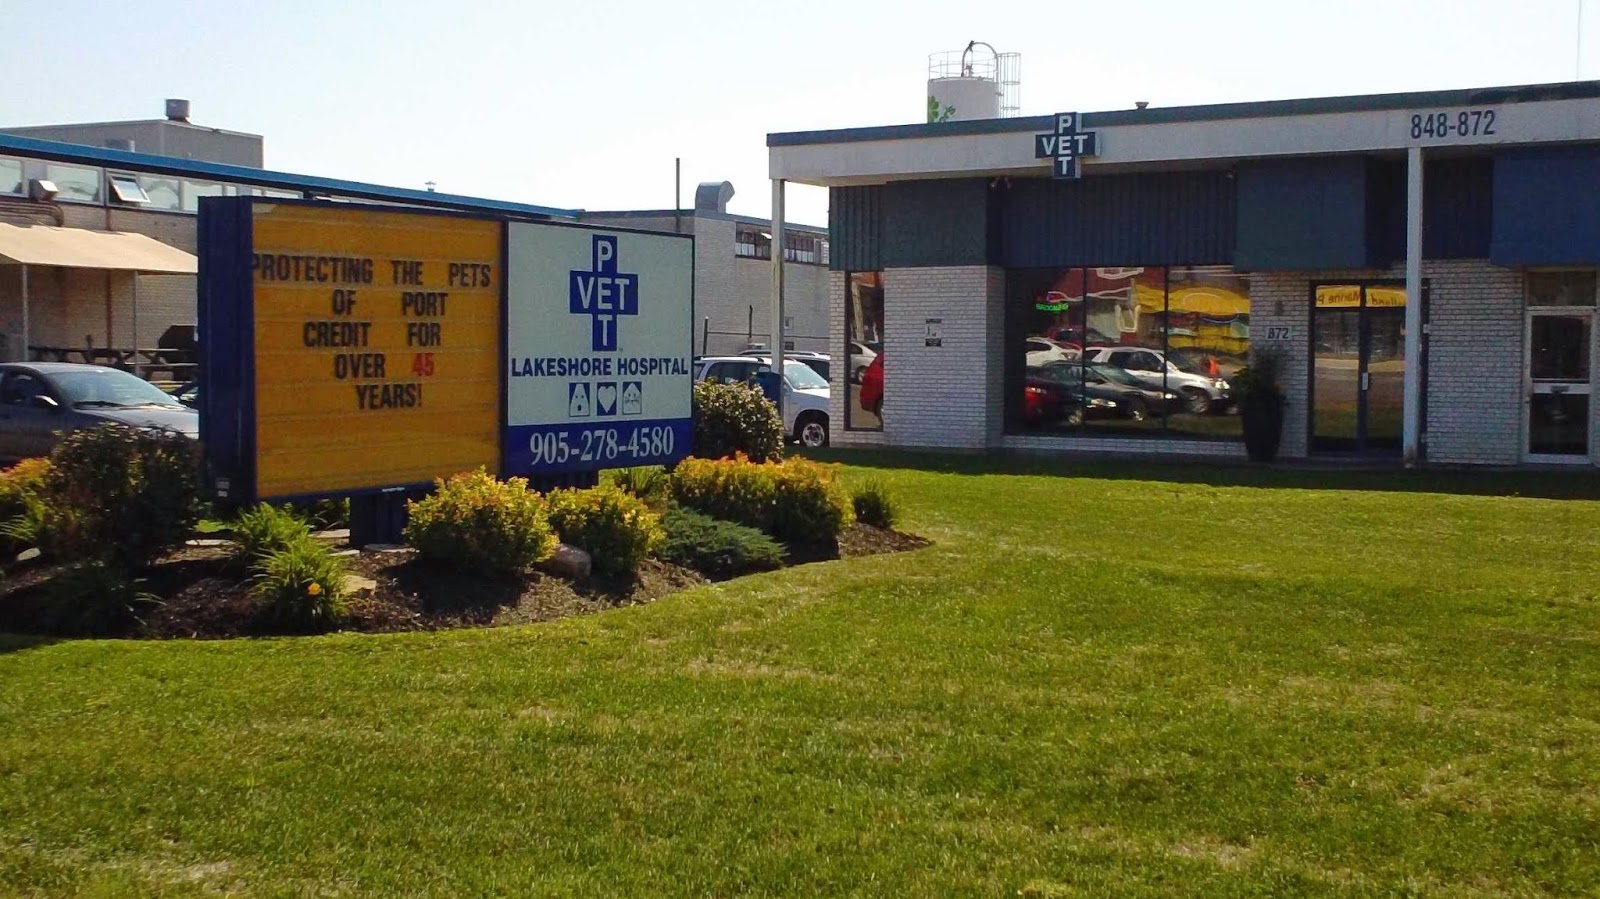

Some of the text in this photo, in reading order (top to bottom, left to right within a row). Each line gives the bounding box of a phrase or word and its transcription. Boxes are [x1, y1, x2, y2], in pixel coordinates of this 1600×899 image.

[1411, 110, 1495, 139] 848-872
[1042, 135, 1088, 155] VET
[1058, 115, 1072, 175] PET
[392, 260, 424, 285] THE
[449, 263, 491, 287] PETS
[332, 289, 448, 316] OF PORT
[577, 276, 630, 310] VET
[597, 240, 613, 346] PET
[304, 322, 441, 347] CREDIT FOR
[1268, 328, 1288, 339] 872
[335, 352, 434, 379] OVER 45
[512, 357, 689, 377] LAKESHORE HOSPITAL
[356, 383, 422, 410] YEARS!
[530, 426, 675, 465] 905-278-4580
